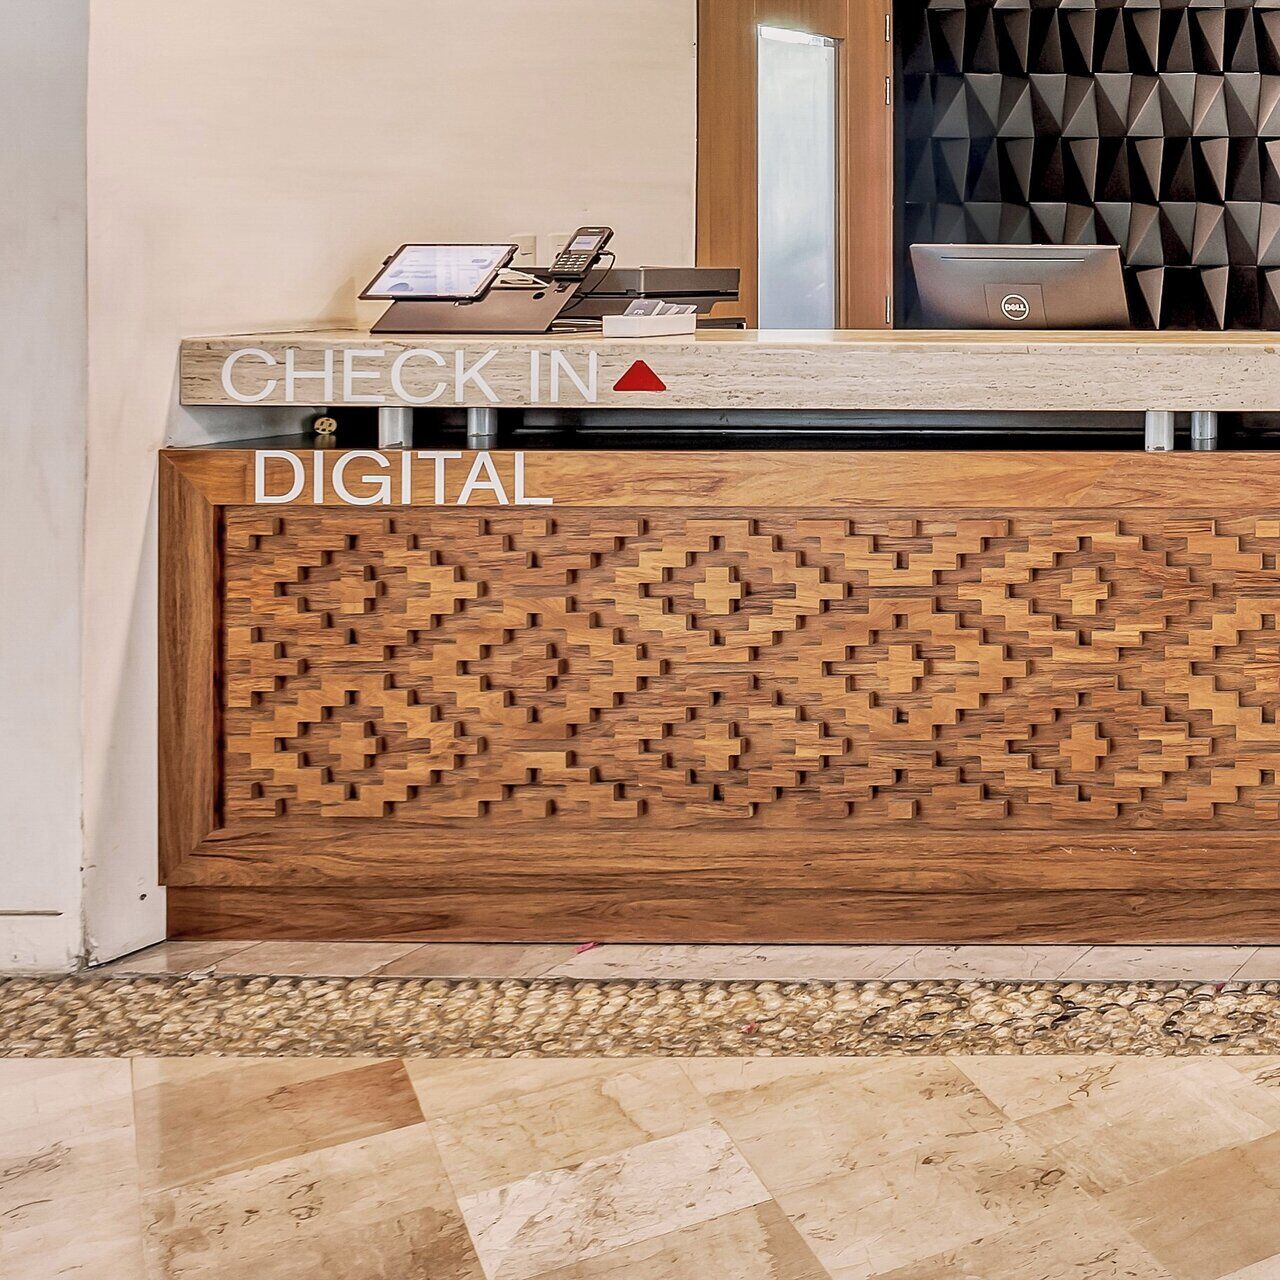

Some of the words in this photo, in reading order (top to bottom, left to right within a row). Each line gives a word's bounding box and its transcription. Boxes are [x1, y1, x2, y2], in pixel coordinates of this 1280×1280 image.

[1005, 303, 1026, 311] DELL
[220, 347, 499, 405] CHECK
[529, 350, 598, 404] IN
[253, 449, 554, 506] DIGITAL
